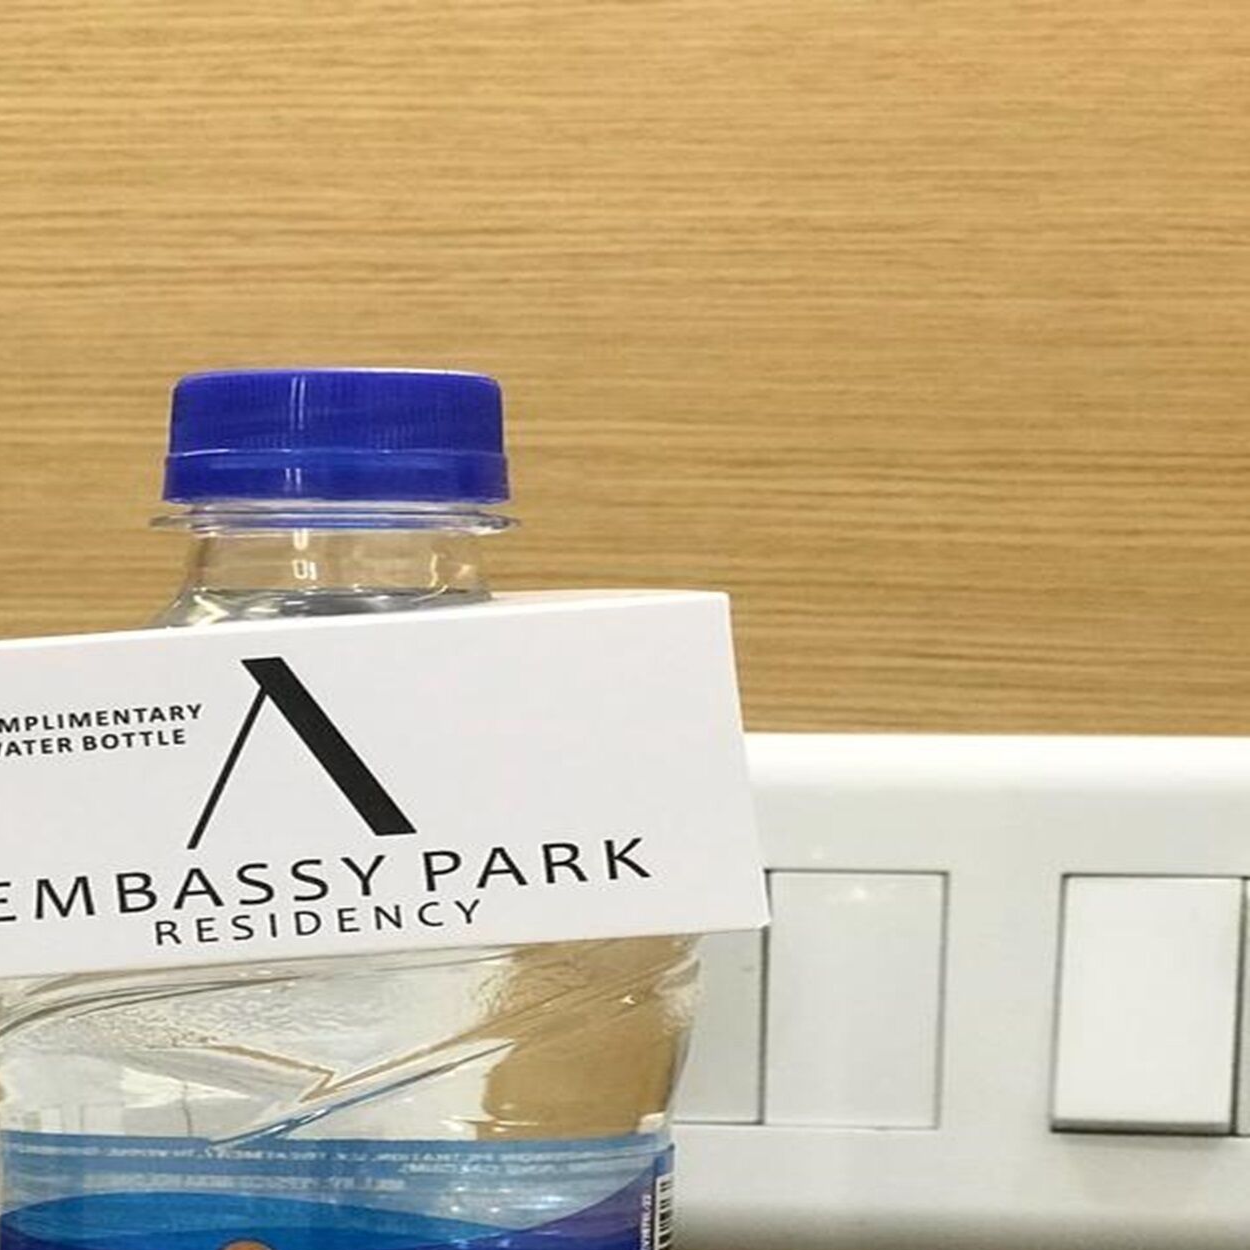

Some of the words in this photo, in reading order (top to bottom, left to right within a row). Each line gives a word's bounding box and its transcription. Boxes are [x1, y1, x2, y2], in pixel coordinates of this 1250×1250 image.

[82, 728, 187, 751] BOTTLE
[422, 837, 651, 892] PARK
[154, 898, 482, 946] RESIDENCY
